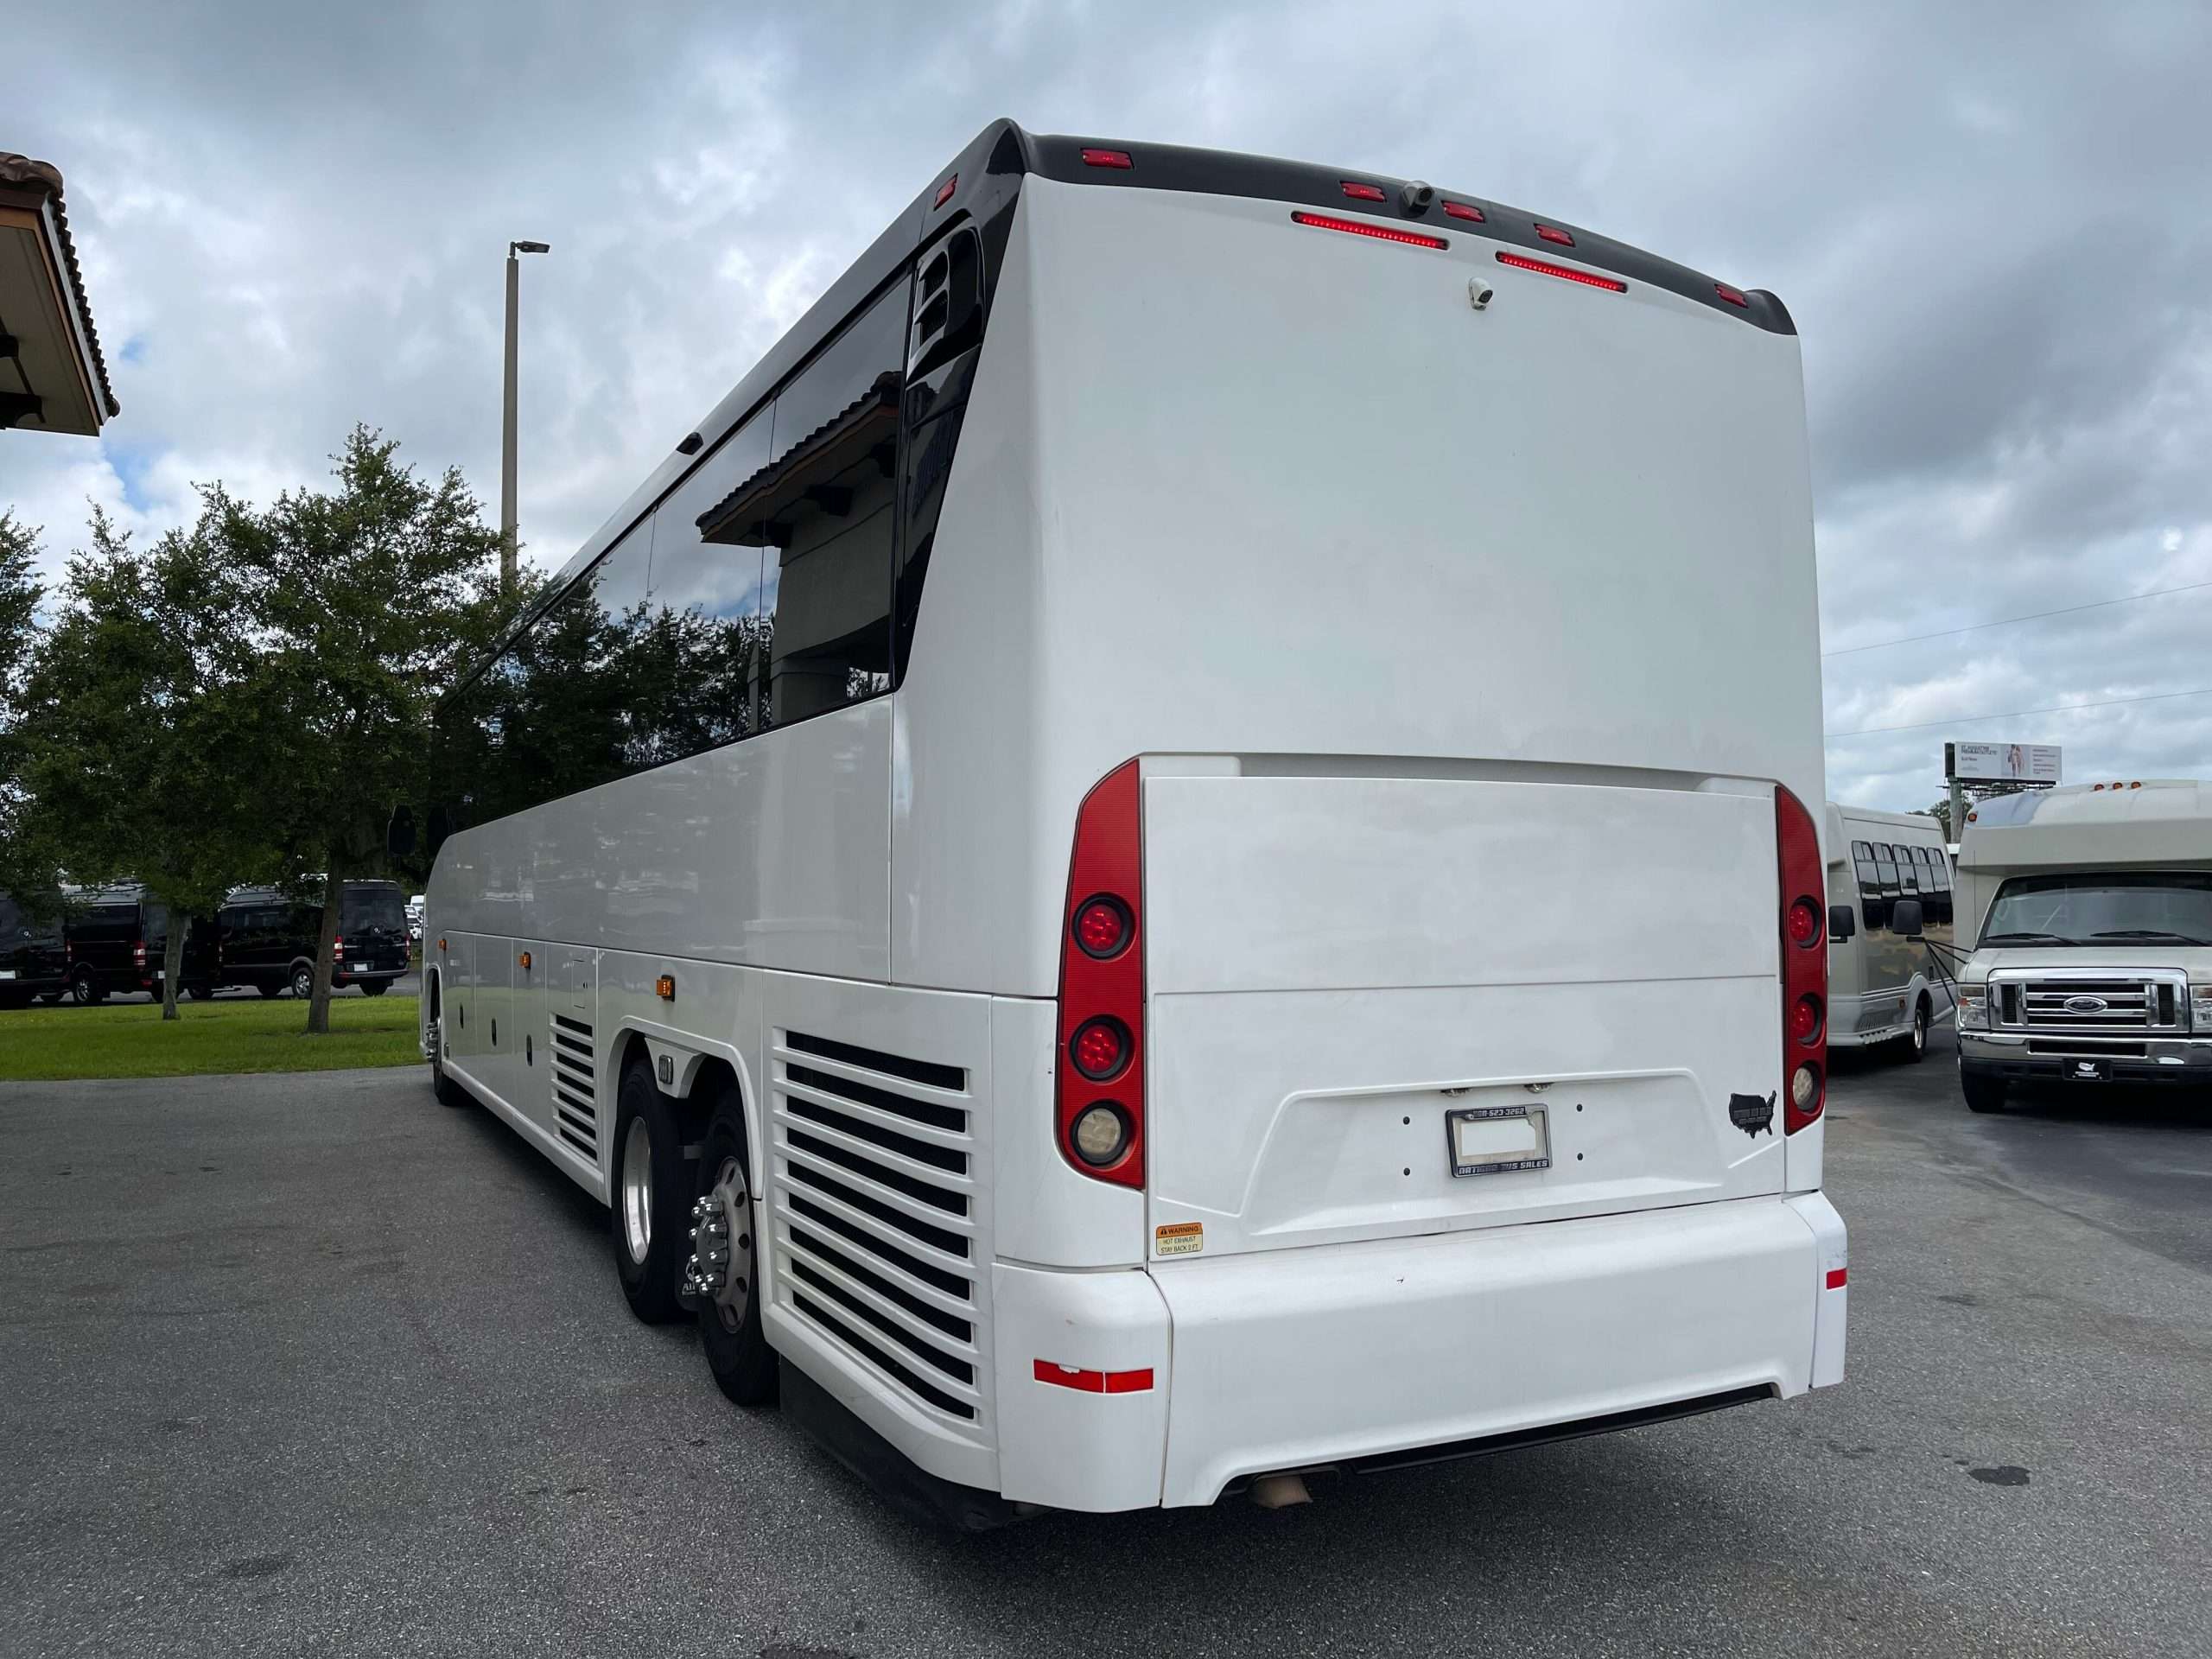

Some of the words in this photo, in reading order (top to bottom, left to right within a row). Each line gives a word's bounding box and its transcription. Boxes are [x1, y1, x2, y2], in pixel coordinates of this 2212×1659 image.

[1473, 1107, 1524, 1117] 0-523-3262
[1520, 1160, 1548, 1169] SALES
[1168, 1225, 1198, 1234] WARNING
